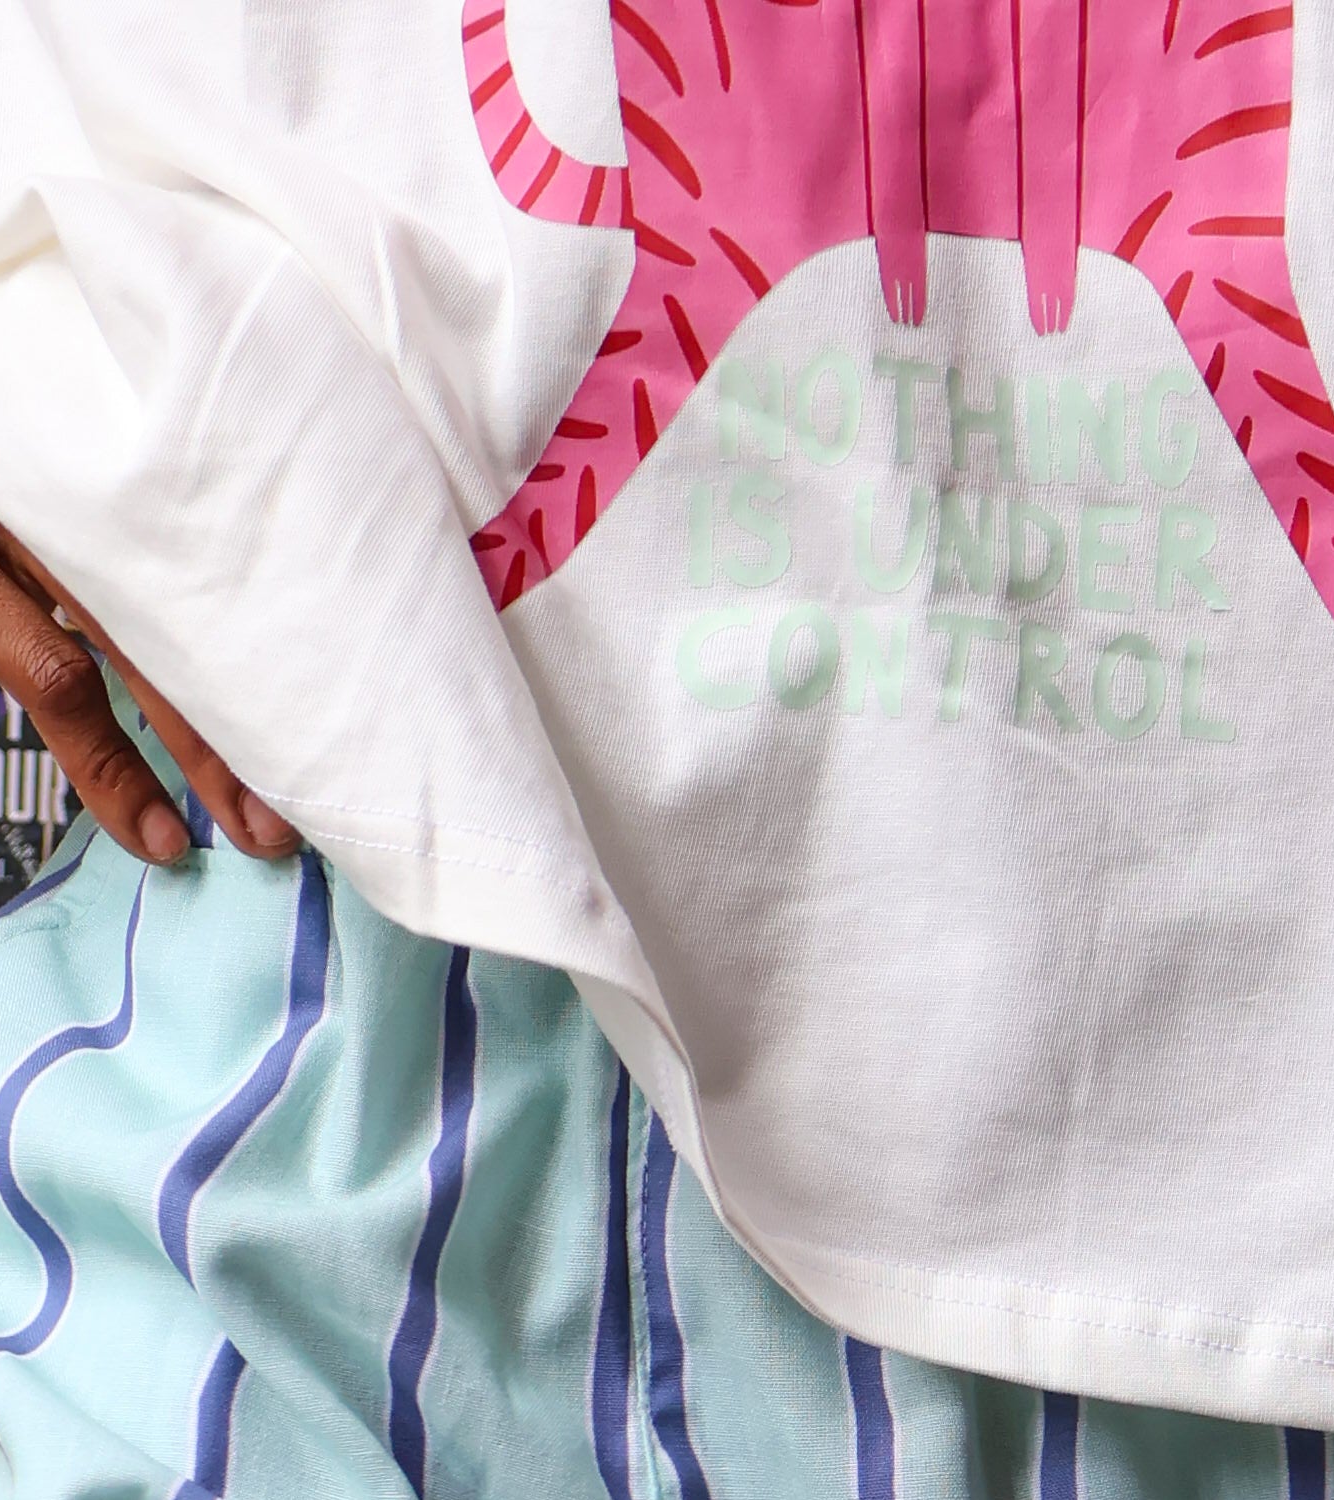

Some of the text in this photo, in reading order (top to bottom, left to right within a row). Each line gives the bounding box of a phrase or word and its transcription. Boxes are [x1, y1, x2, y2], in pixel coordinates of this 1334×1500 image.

[716, 347, 1199, 490] NOTHING
[687, 472, 1233, 613] IS UNDER
[674, 601, 1237, 743] CONTROL
